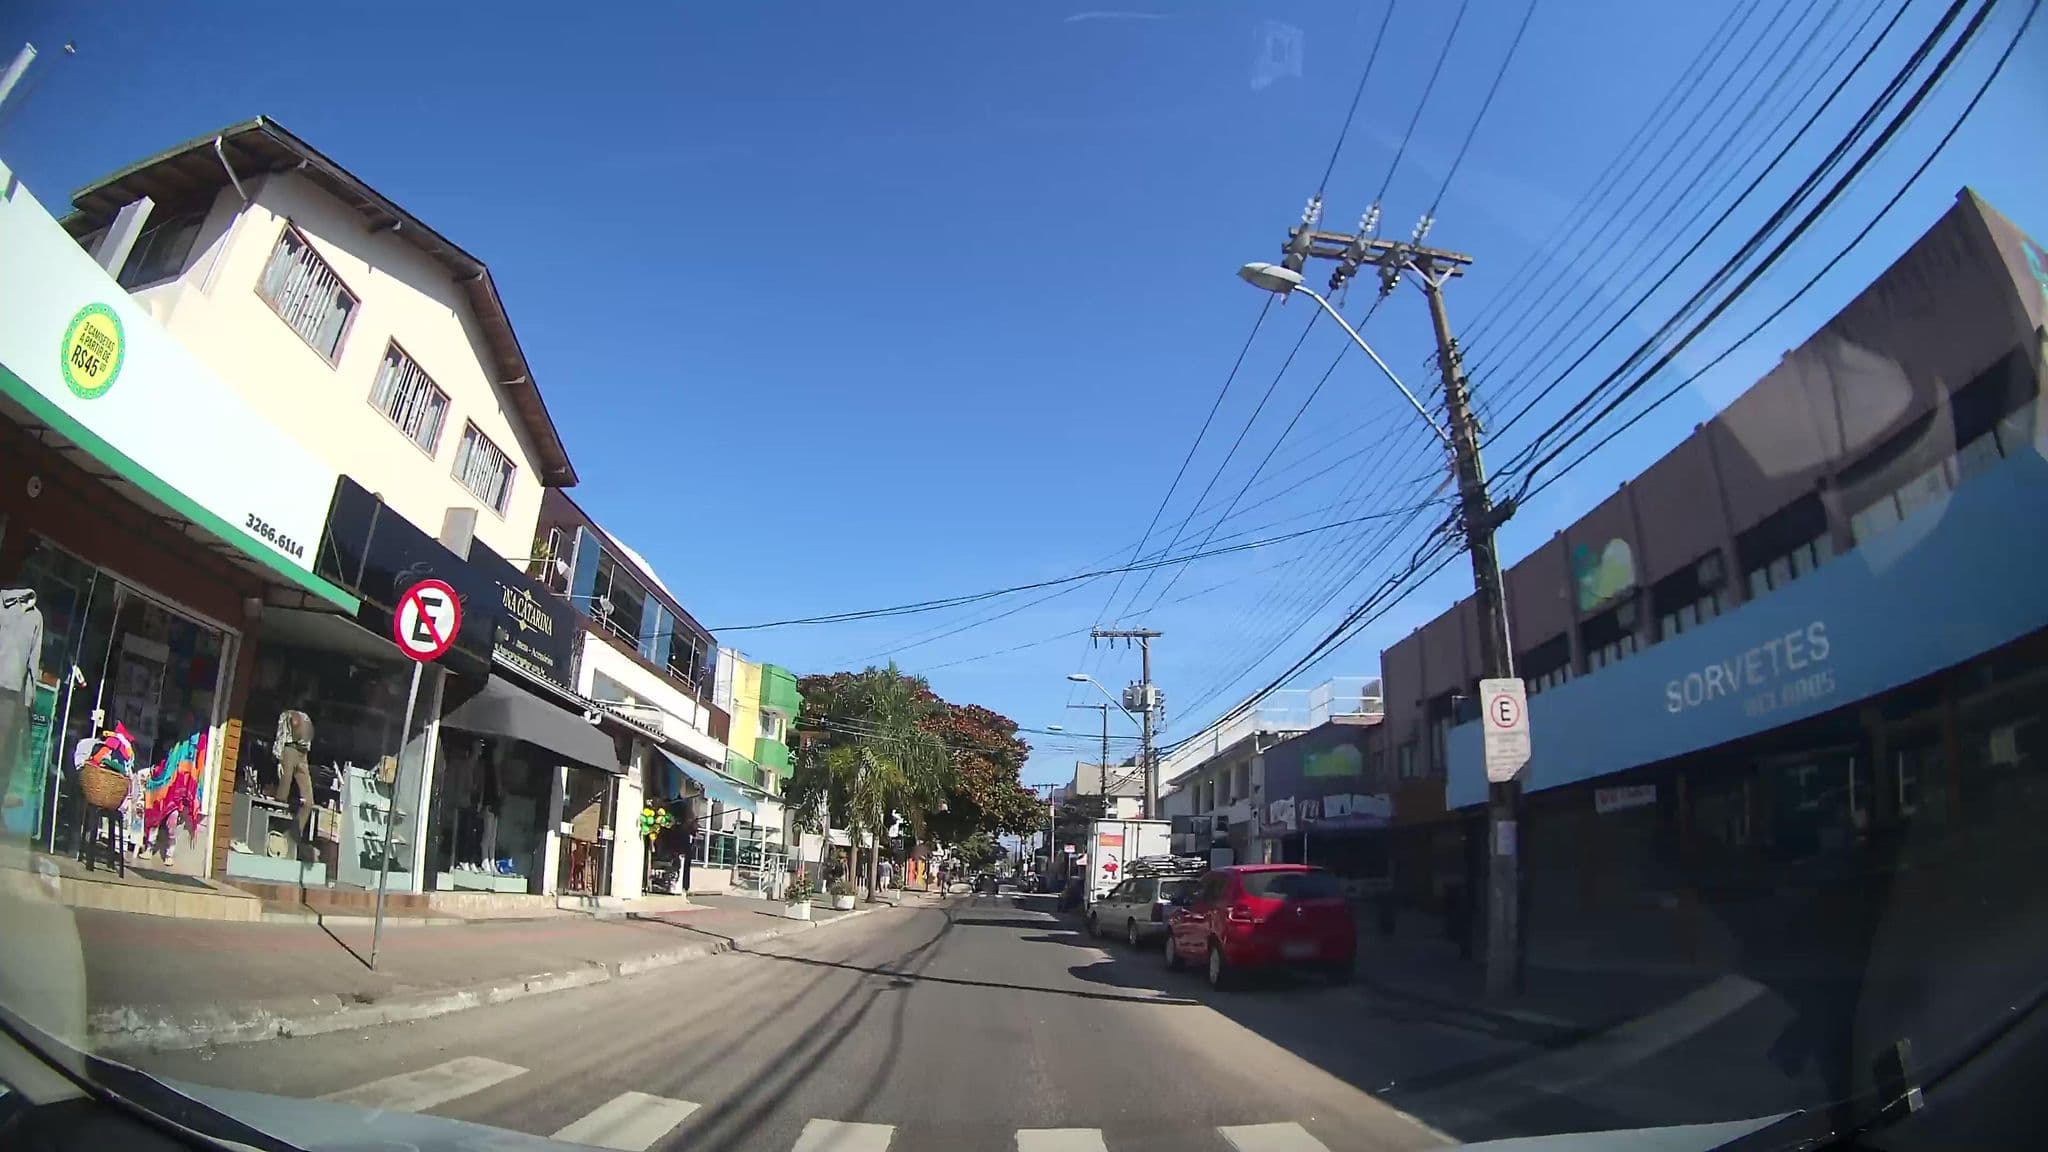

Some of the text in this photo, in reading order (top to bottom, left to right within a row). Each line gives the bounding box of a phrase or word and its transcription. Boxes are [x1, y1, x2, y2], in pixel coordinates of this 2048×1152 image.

[84, 321, 115, 352] 3 CAMISETAS
[84, 335, 104, 358] PARTIR
[102, 349, 111, 364] DE
[245, 513, 304, 559] 3266.6114
[412, 596, 443, 644] E
[517, 597, 553, 637] CATARINA
[1666, 621, 1830, 714] SORVETES
[1500, 701, 1511, 722] E
